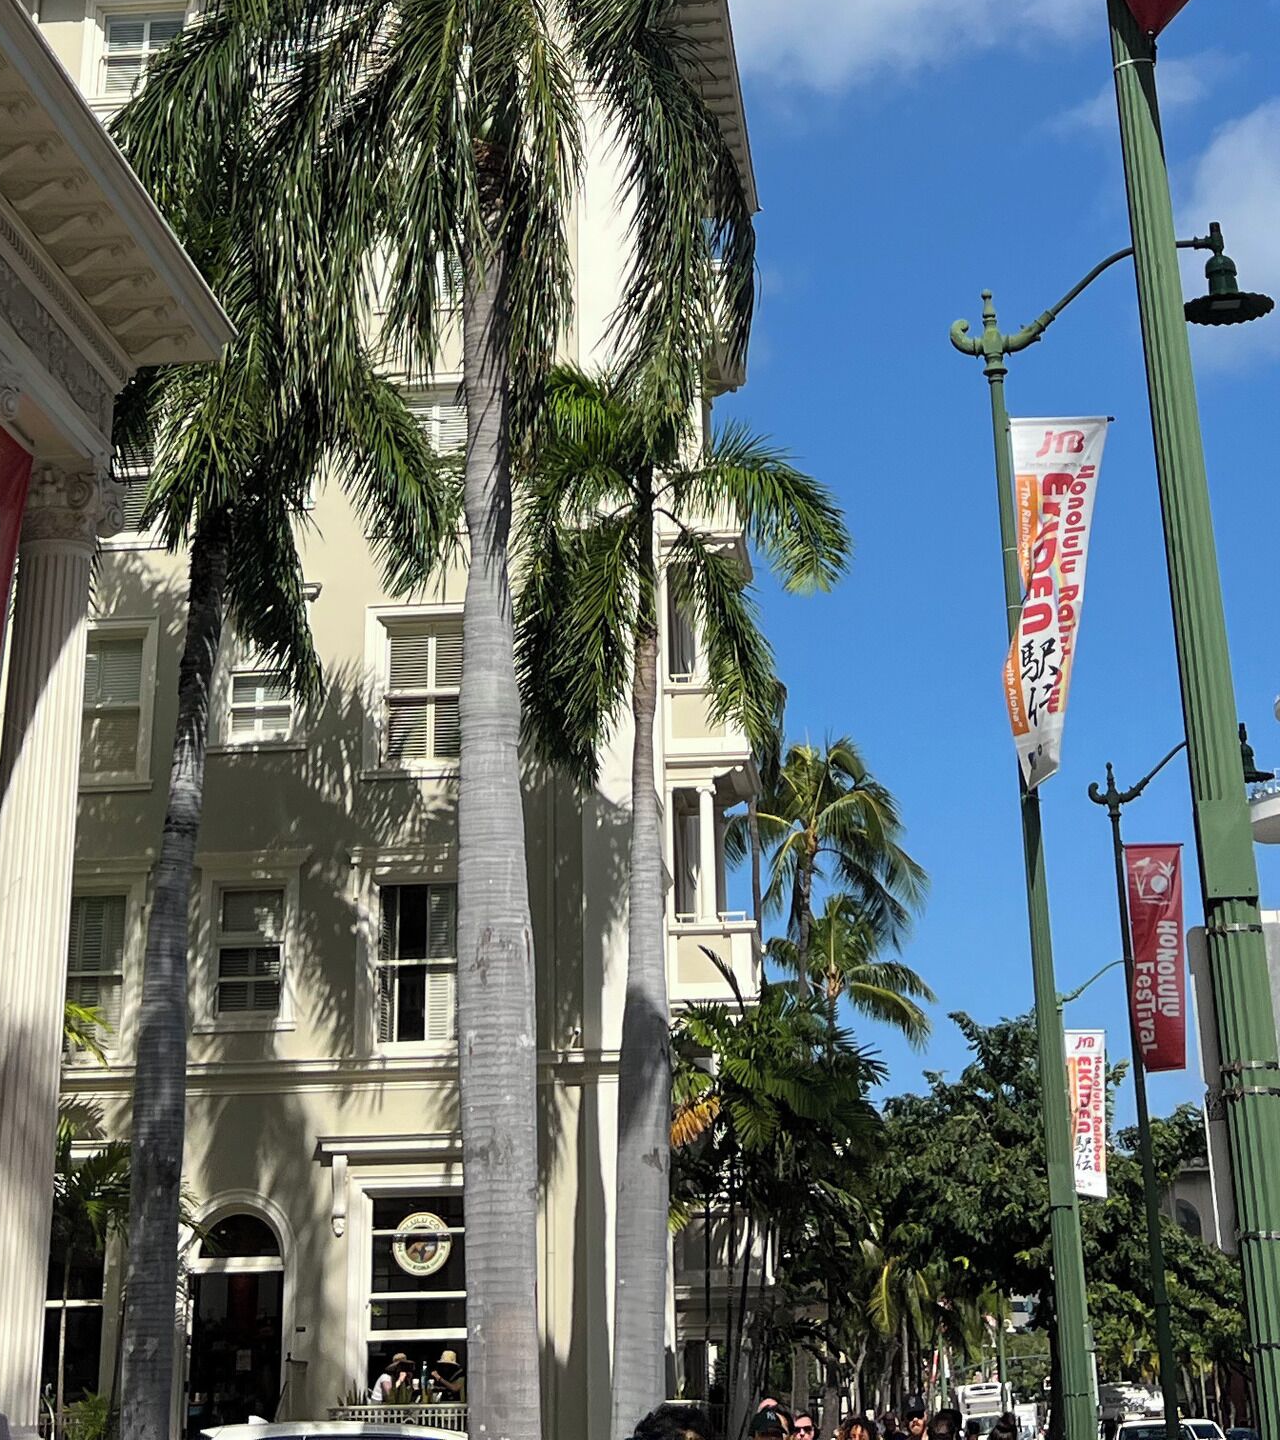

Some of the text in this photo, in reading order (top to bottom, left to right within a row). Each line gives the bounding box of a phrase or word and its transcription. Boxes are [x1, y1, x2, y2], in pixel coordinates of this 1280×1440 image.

[1035, 429, 1085, 458] JTB
[1155, 919, 1180, 1018] HONOLULU
[1092, 1056, 1103, 1172] Honolulu Rainbow
